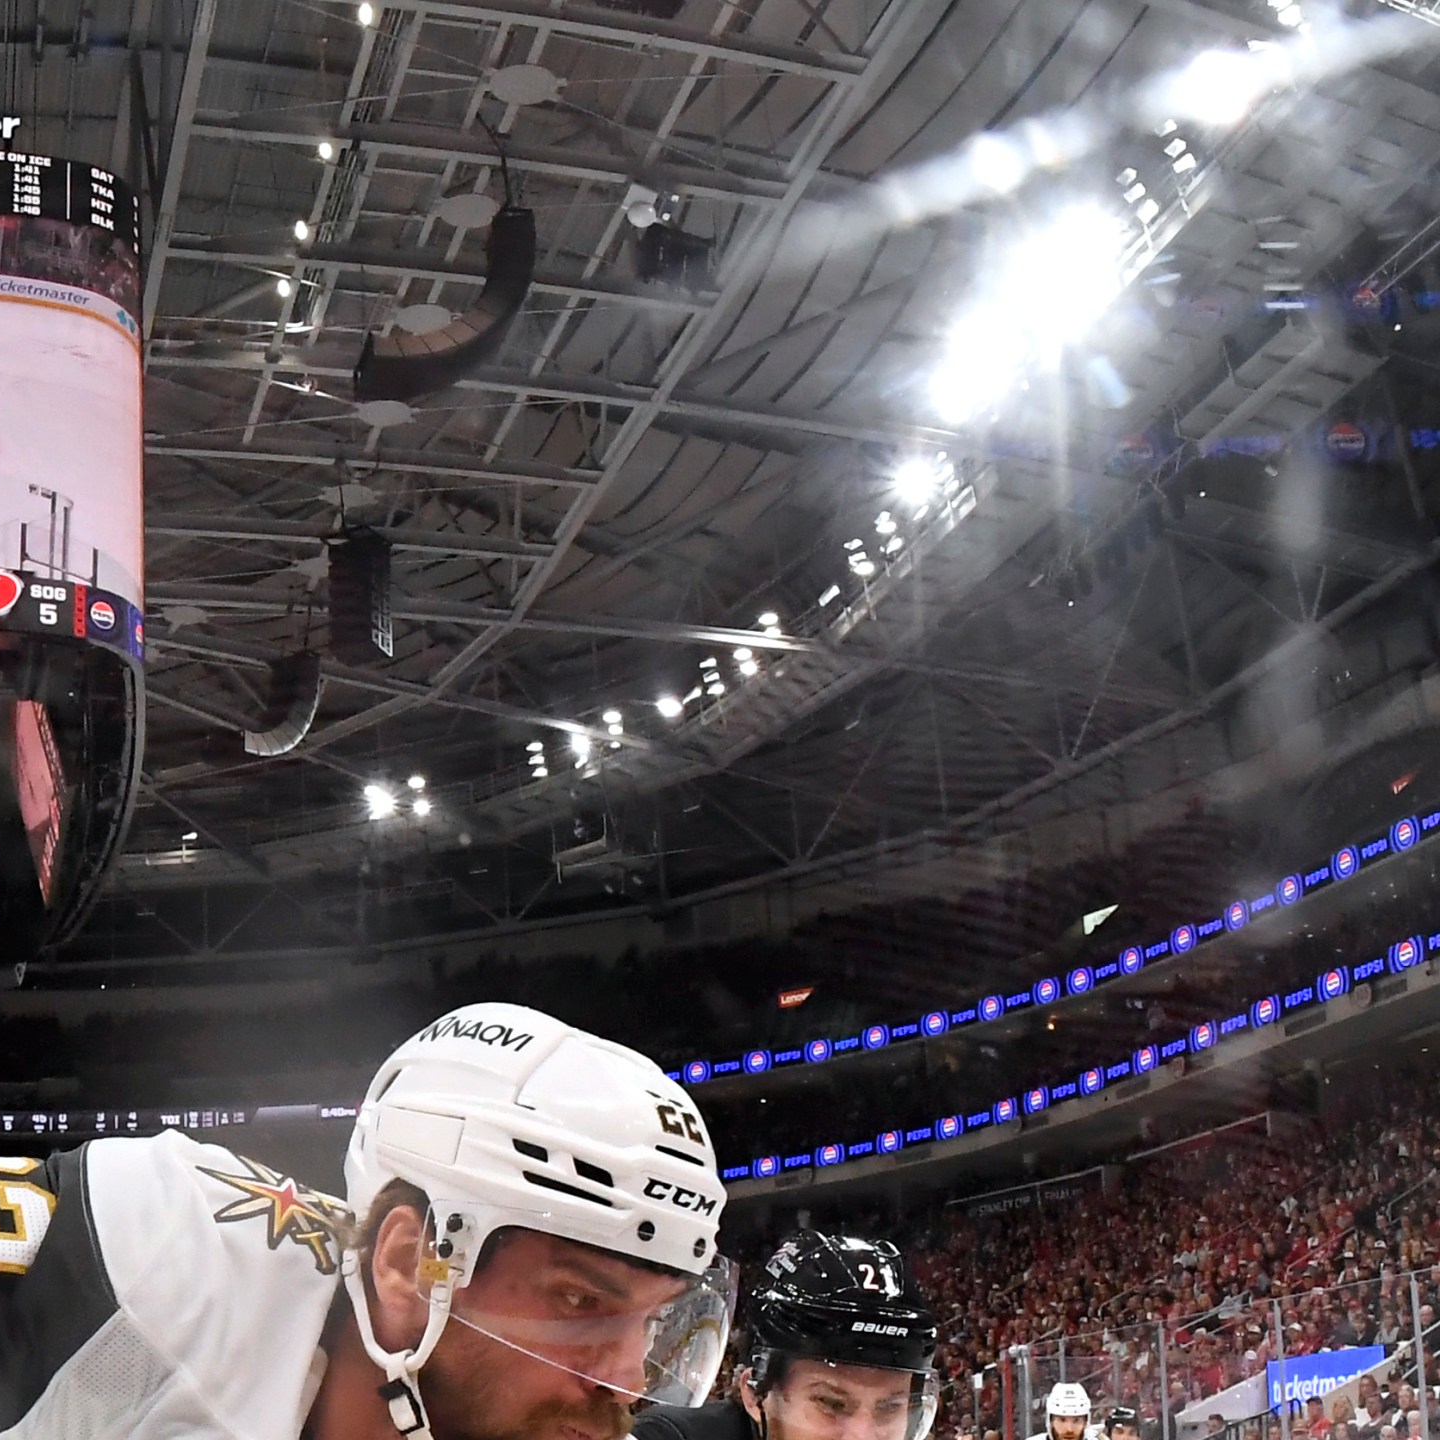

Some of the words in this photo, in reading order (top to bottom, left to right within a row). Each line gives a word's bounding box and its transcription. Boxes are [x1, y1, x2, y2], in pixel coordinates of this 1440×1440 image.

[7, 152, 26, 163] ON
[28, 156, 51, 167] ICE
[14, 163, 40, 174] 1:41
[13, 173, 40, 184] 1:41
[91, 183, 115, 200] TKA
[91, 198, 113, 213] HIT
[91, 214, 114, 231] BLK
[30, 585, 66, 600] SOG
[40, 603, 58, 625] 5
[1362, 840, 1387, 859] PEPSI
[1305, 868, 1329, 887] PEPSI
[1251, 895, 1274, 912] PEPSI
[1199, 919, 1222, 936] PEPSI
[1146, 942, 1168, 958] PEPSI
[1096, 963, 1117, 979] PEPSI
[1354, 959, 1383, 980] PEPSI
[1006, 993, 1030, 1007] PEPSI
[1285, 988, 1312, 1008] PEPSI
[952, 1010, 975, 1023] PEPSI
[1221, 1014, 1247, 1034] PEPSI
[893, 1025, 917, 1037] PEPSI
[835, 1038, 858, 1050] PEPSI
[1162, 1040, 1186, 1057] PEPSI
[775, 1051, 800, 1062] PEPSI
[714, 1061, 739, 1073] PEPSI
[1107, 1062, 1130, 1079] PEPSI
[1052, 1084, 1076, 1098] PEPSI
[160, 1115, 180, 1125] TOI
[967, 1113, 990, 1126] PEPSI
[907, 1128, 931, 1142] PEPSI
[849, 1143, 872, 1155] PEPSI
[785, 1155, 810, 1167] PEPSI
[724, 1166, 748, 1178] PEPSI
[643, 1177, 716, 1216] CCM
